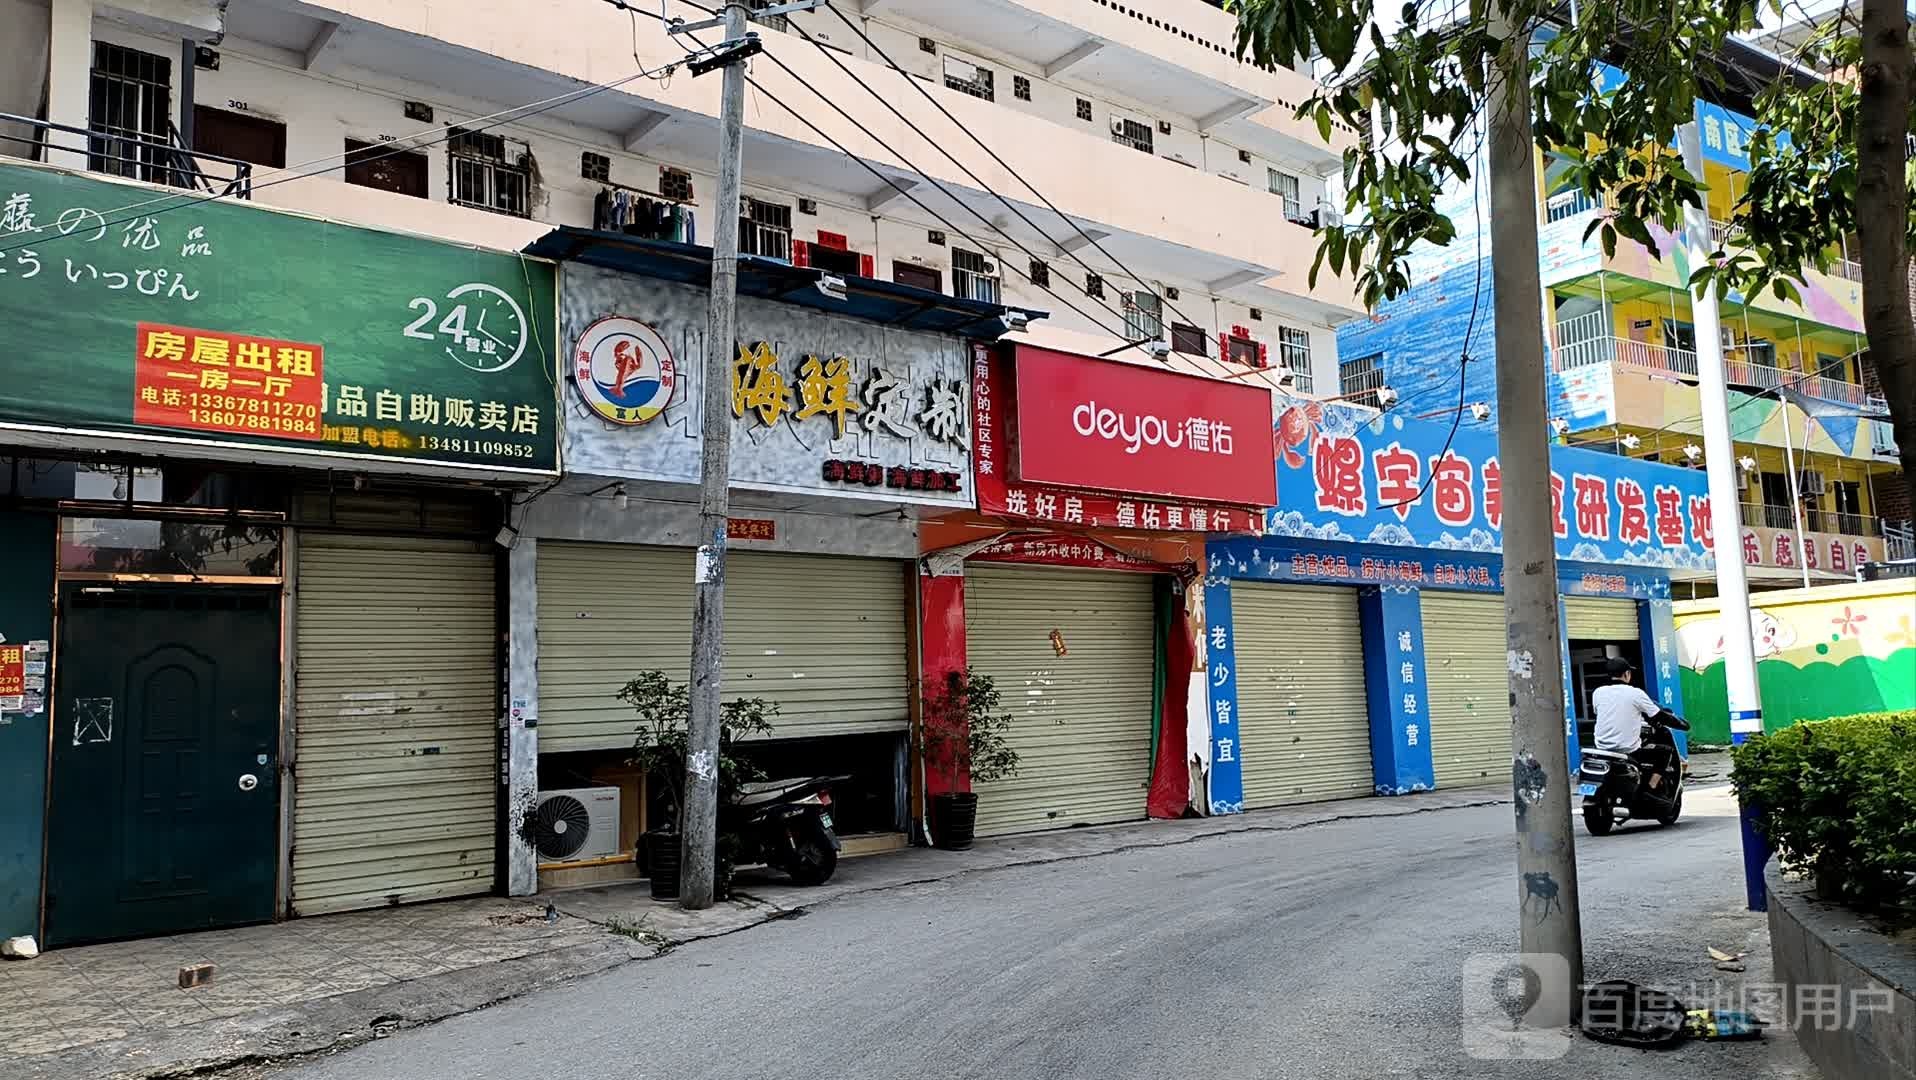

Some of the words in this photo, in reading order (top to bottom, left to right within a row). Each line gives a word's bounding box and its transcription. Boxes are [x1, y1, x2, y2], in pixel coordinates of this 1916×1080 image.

[228, 99, 248, 110] 301
[65, 259, 200, 301] いっぴん
[403, 297, 470, 344] 24
[144, 331, 316, 377] 房屋出租
[465, 337, 497, 355] 营业
[167, 369, 293, 397] 一房一厅
[732, 340, 971, 452] 海鲜定制
[189, 409, 316, 433] 13607881984
[321, 383, 540, 434] 品自助贩卖店
[975, 345, 994, 475] 更用心的社区专家
[419, 435, 534, 458] 13481109852
[1211, 625, 1235, 762] 老少皆宜
[1398, 631, 1419, 746] 诚信经营
